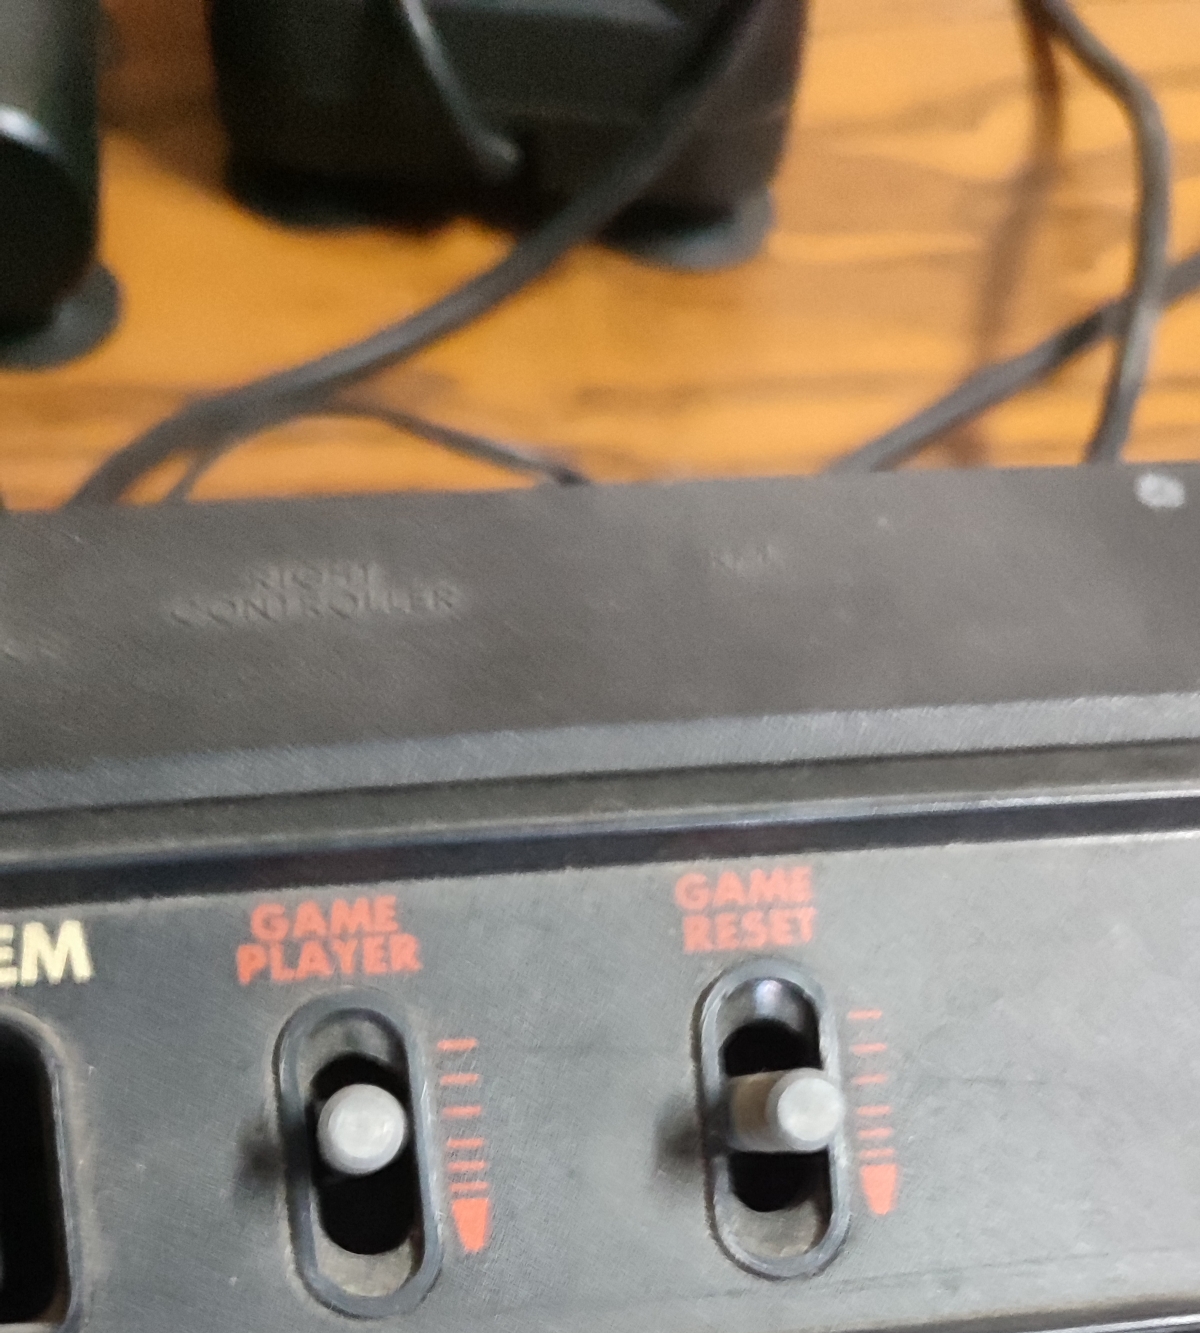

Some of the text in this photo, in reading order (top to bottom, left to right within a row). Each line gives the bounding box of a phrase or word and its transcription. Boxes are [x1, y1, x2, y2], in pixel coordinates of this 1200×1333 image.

[675, 867, 812, 911] GAME
[249, 896, 398, 941] GAME
[683, 907, 817, 954] RESET
[236, 933, 421, 984] PLAYER
